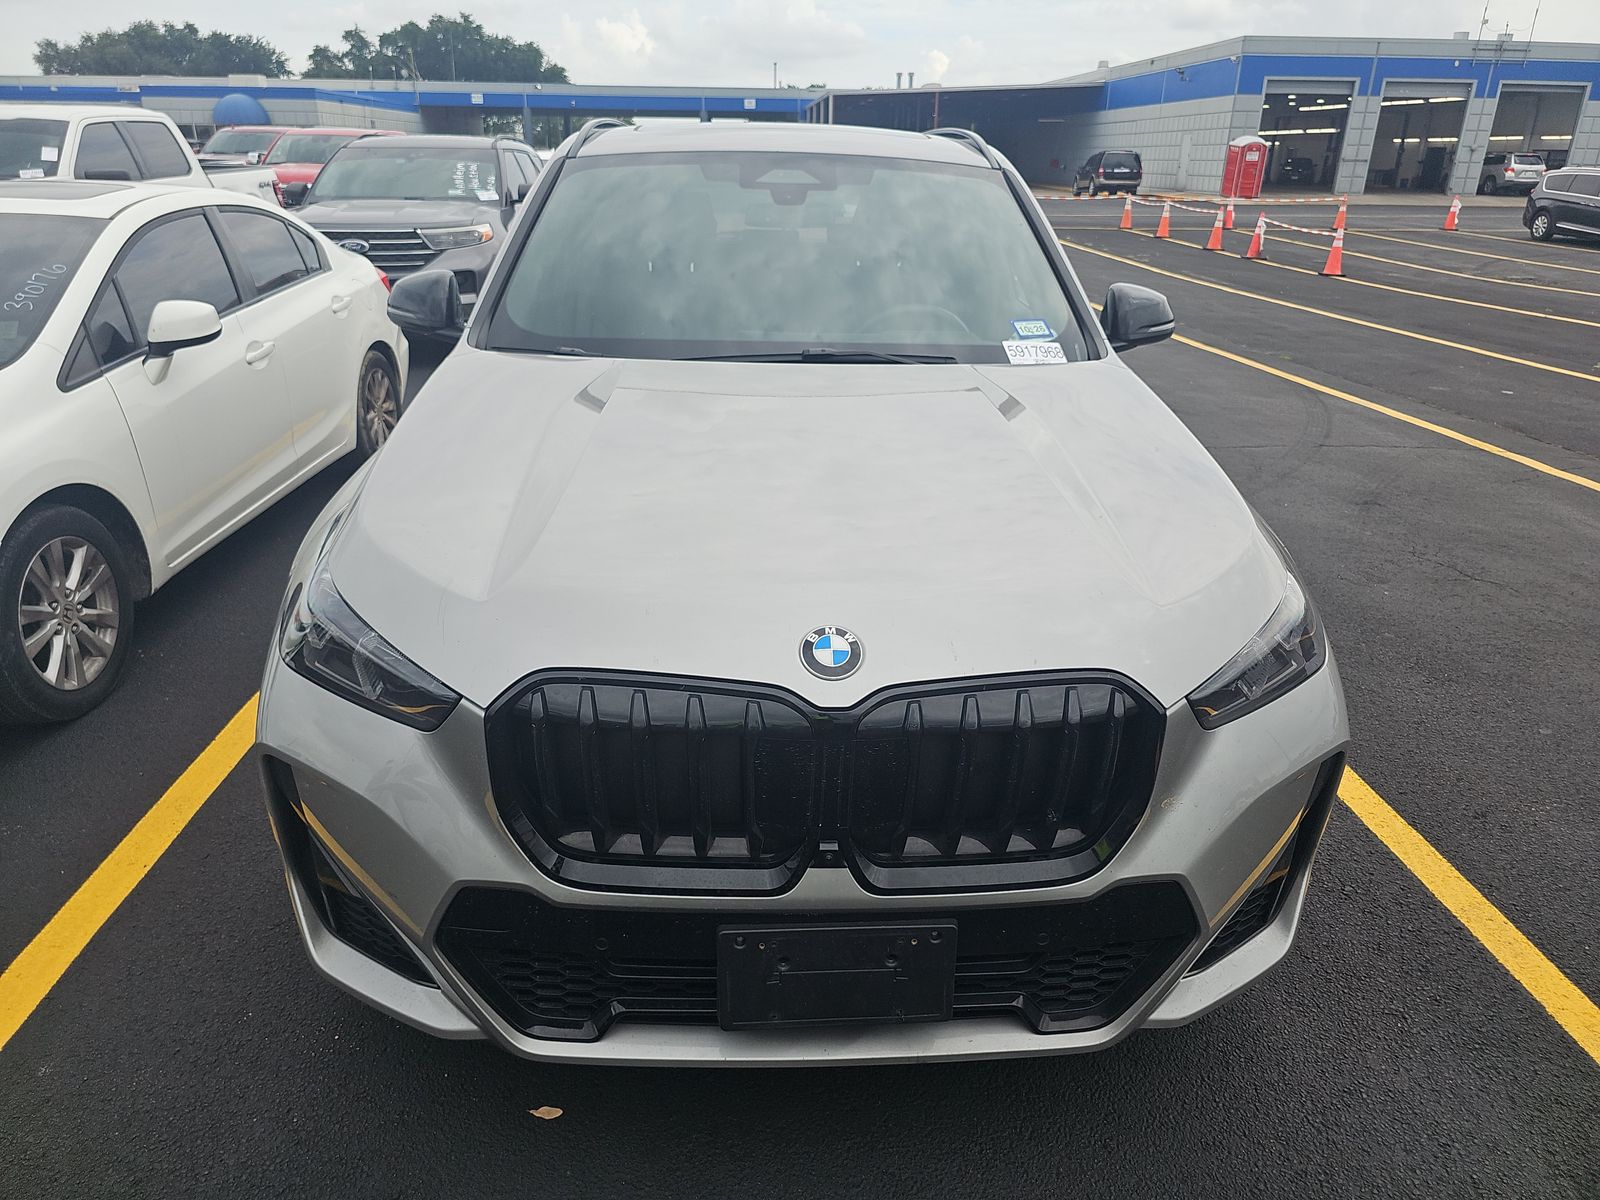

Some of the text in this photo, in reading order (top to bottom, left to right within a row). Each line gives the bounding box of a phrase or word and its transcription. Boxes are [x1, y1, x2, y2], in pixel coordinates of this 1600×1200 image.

[4, 264, 67, 310] 390176
[1007, 344, 1064, 358] 5917968
[806, 627, 857, 643] BMW
